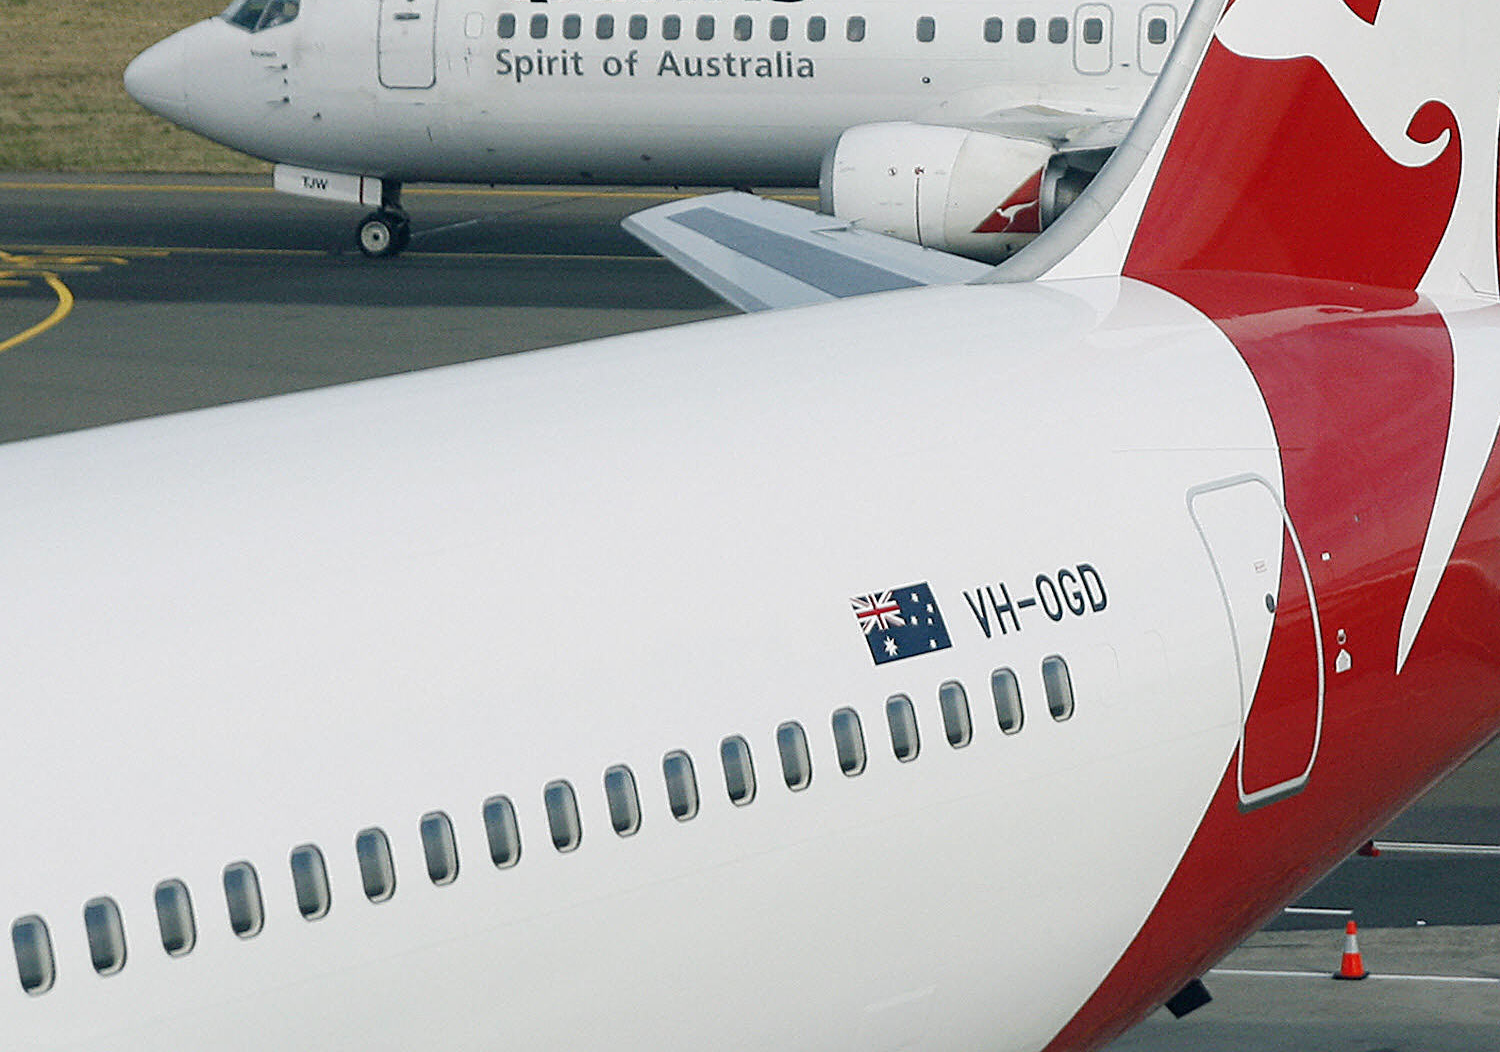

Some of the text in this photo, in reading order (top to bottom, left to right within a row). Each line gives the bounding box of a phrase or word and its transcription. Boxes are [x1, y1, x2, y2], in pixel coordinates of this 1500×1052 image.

[496, 49, 815, 82] Spirit of Australia
[302, 175, 328, 189] TJW
[963, 563, 1107, 638] VH-OGD
